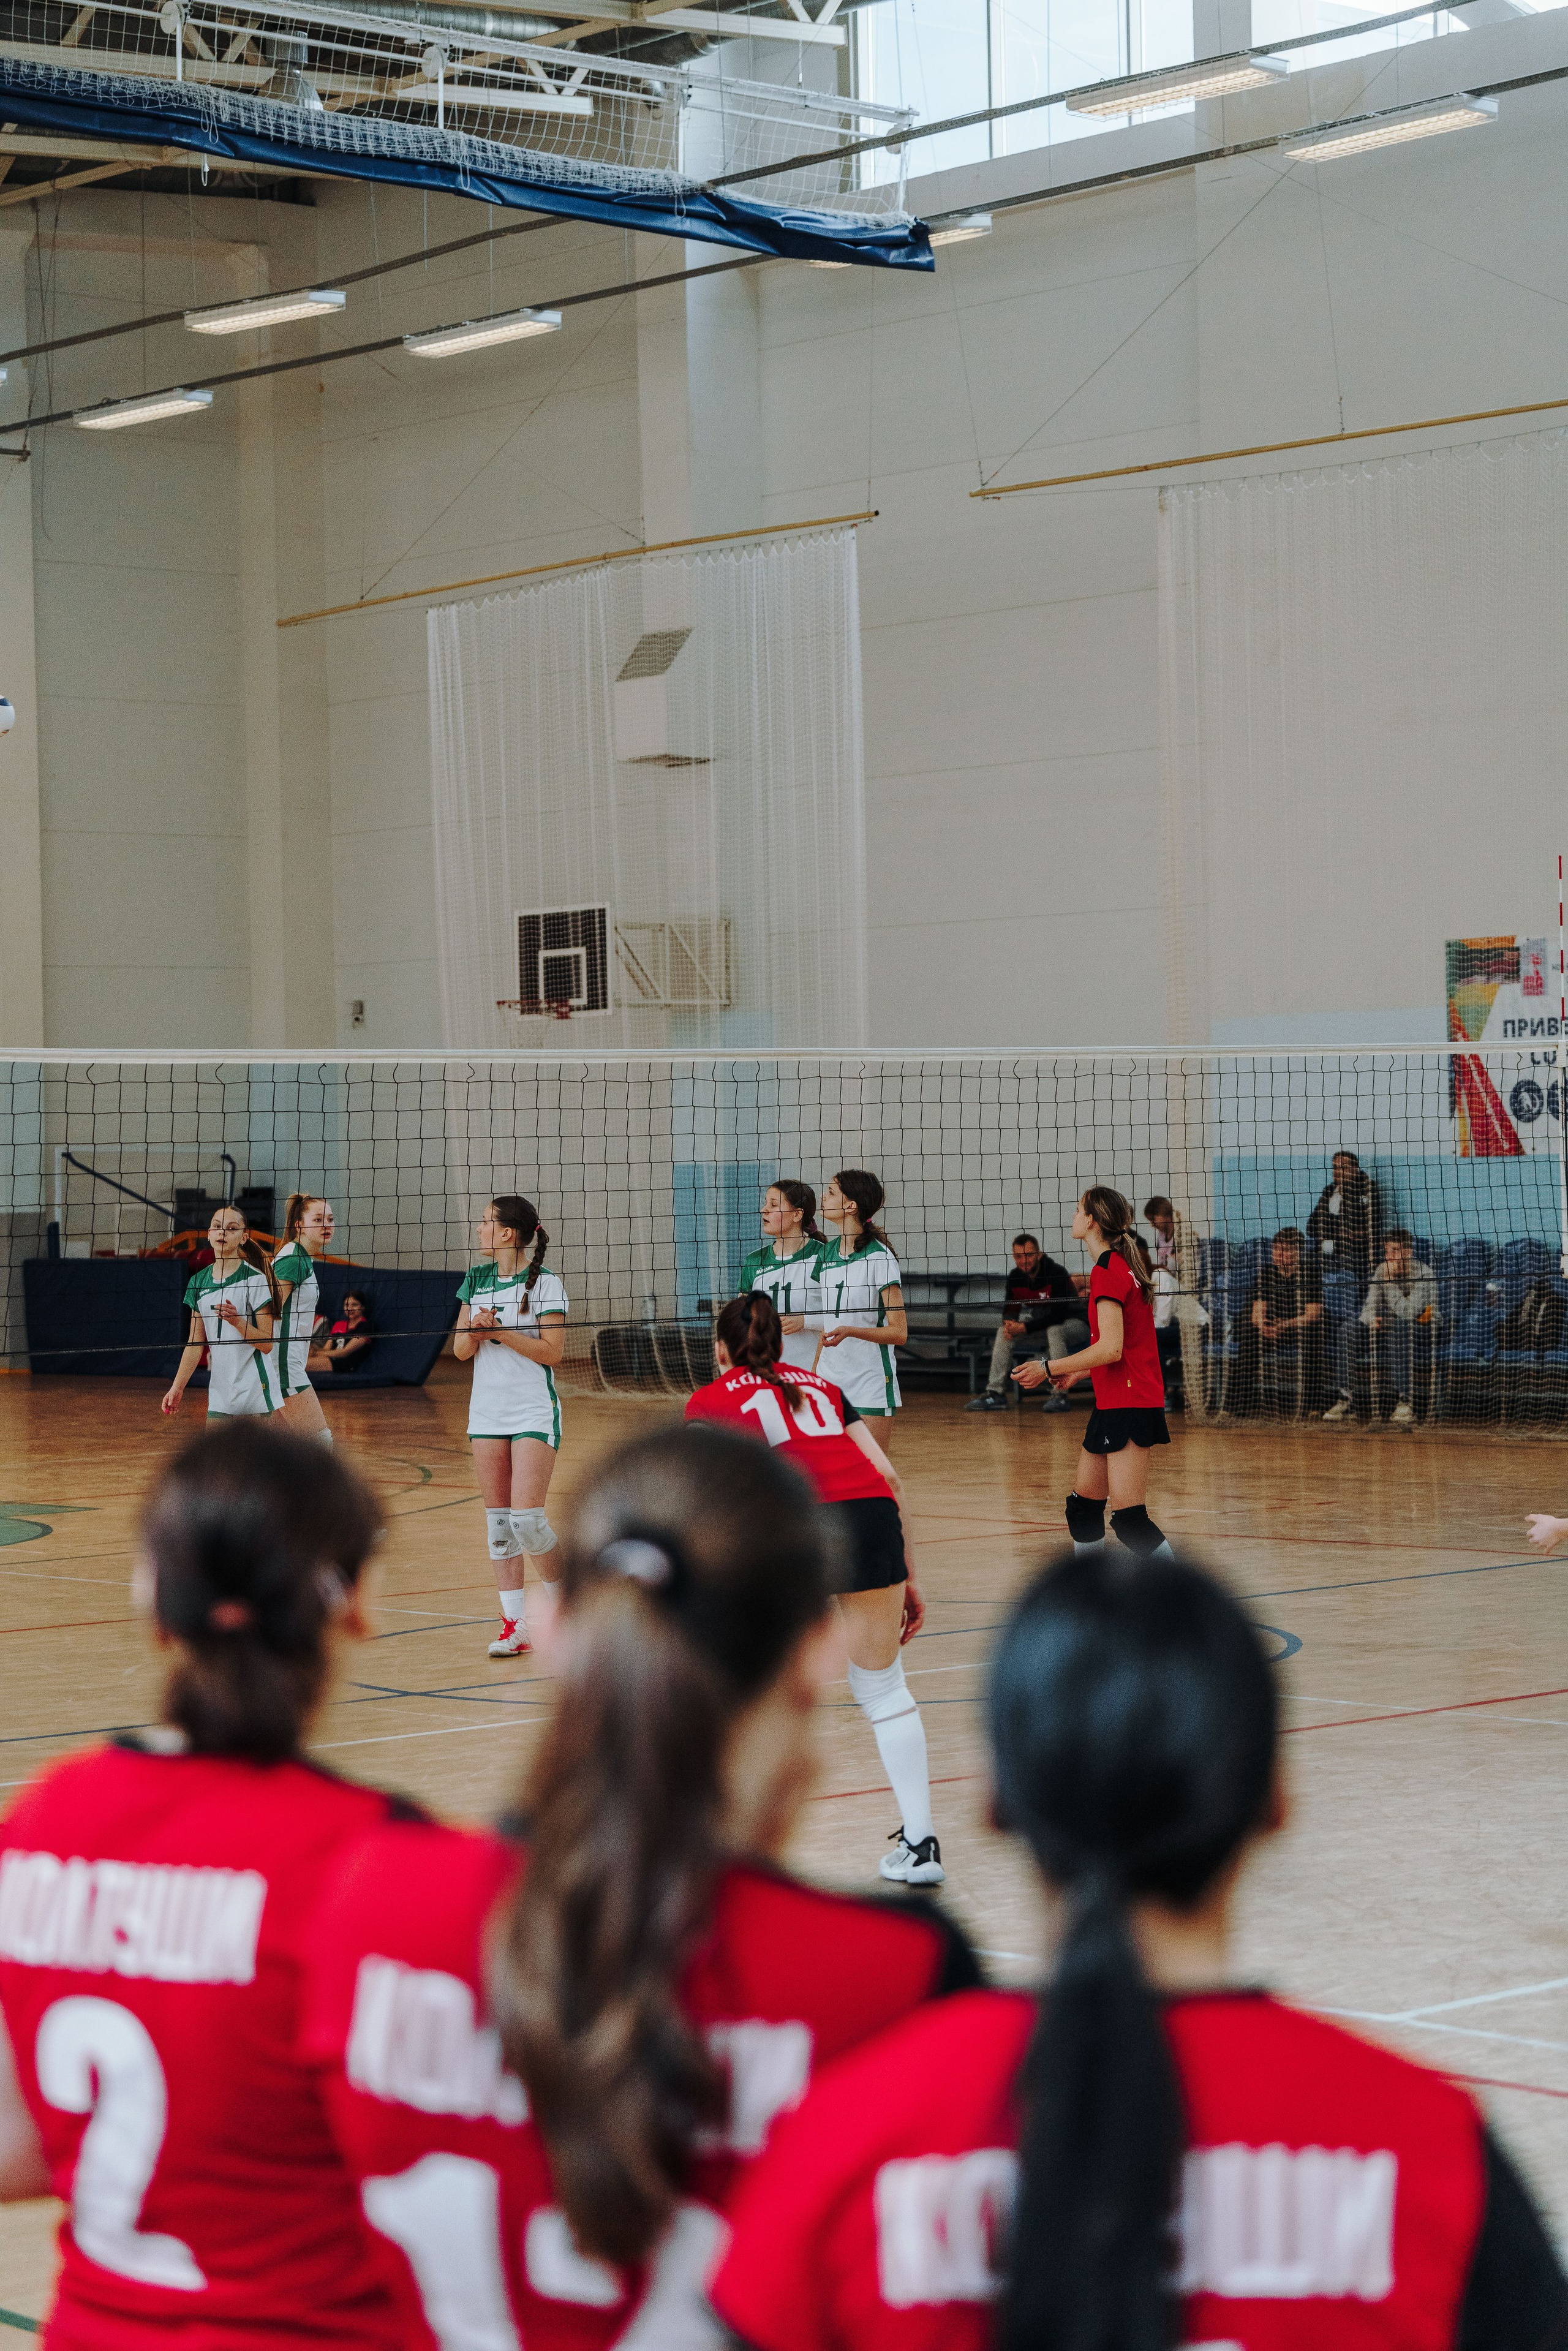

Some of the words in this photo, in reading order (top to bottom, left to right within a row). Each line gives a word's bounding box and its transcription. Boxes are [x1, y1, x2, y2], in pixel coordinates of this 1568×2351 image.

[769, 1281, 792, 1314] 11
[835, 1280, 844, 1318] 1
[740, 1384, 845, 1448] 10
[35, 1994, 209, 2292] 2
